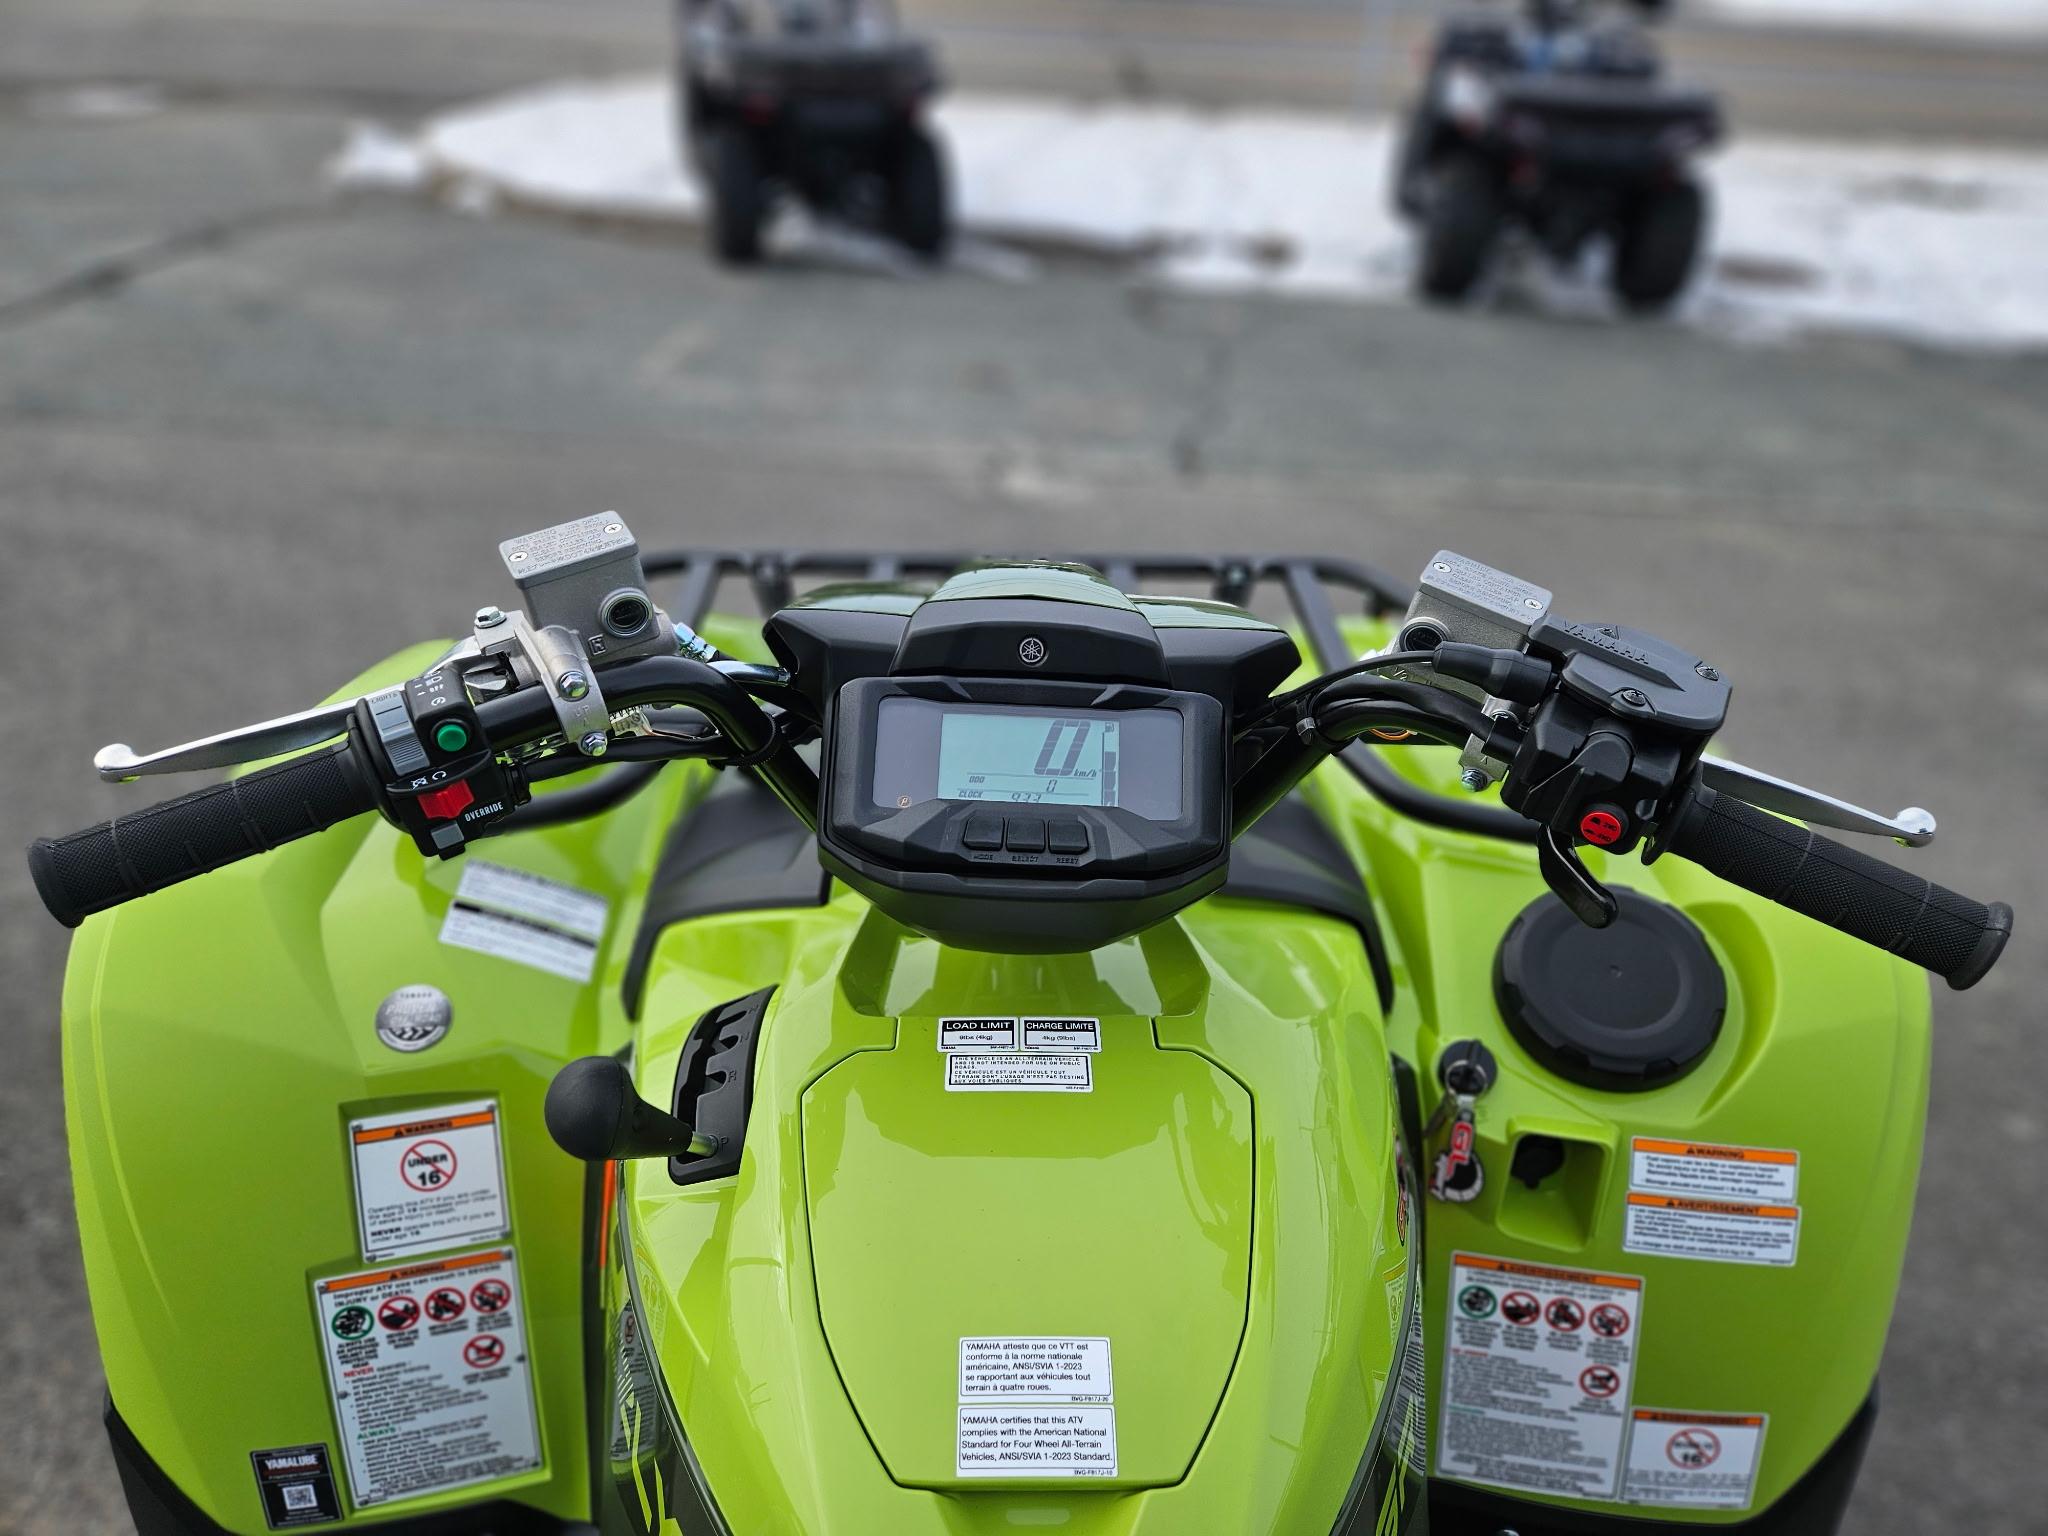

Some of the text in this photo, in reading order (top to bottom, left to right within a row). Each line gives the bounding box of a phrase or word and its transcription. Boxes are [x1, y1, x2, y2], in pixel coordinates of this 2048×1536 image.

[1564, 620, 1649, 665] YAMAHA
[1033, 719, 1097, 778] 0 km/h
[958, 790, 983, 798] CLOCK
[465, 801, 504, 822] OVERRIDE
[1055, 857, 1079, 865] RESET
[946, 1021, 1011, 1030] LOAD LIMIT
[1026, 1022, 1094, 1030] CHARGE LIMITE
[404, 1119, 453, 1135] WARNING
[407, 1152, 447, 1168] UNDER
[417, 1169, 441, 1187] 16
[370, 1226, 401, 1236] NEVER
[1004, 1352, 1010, 1360] à
[1011, 1352, 1018, 1360] la
[966, 1362, 1082, 1371] américaine, ANSI/SVIA 1-2023
[976, 1373, 1018, 1382] rapportant
[1036, 1372, 1073, 1380] véhicules
[965, 1383, 991, 1391] terrain
[992, 1383, 998, 1391] à
[999, 1384, 1025, 1392] quatre
[962, 1416, 1083, 1424] YAMAHA certifies that this ATV
[962, 1428, 1107, 1437] complies with the American National
[962, 1440, 1102, 1448] Standard for Four Wheel All-Terrain
[962, 1452, 1113, 1462] Vehicles, ANSI/SVIA 1-2023 Standard.
[265, 1454, 319, 1470] YAMALUBE
